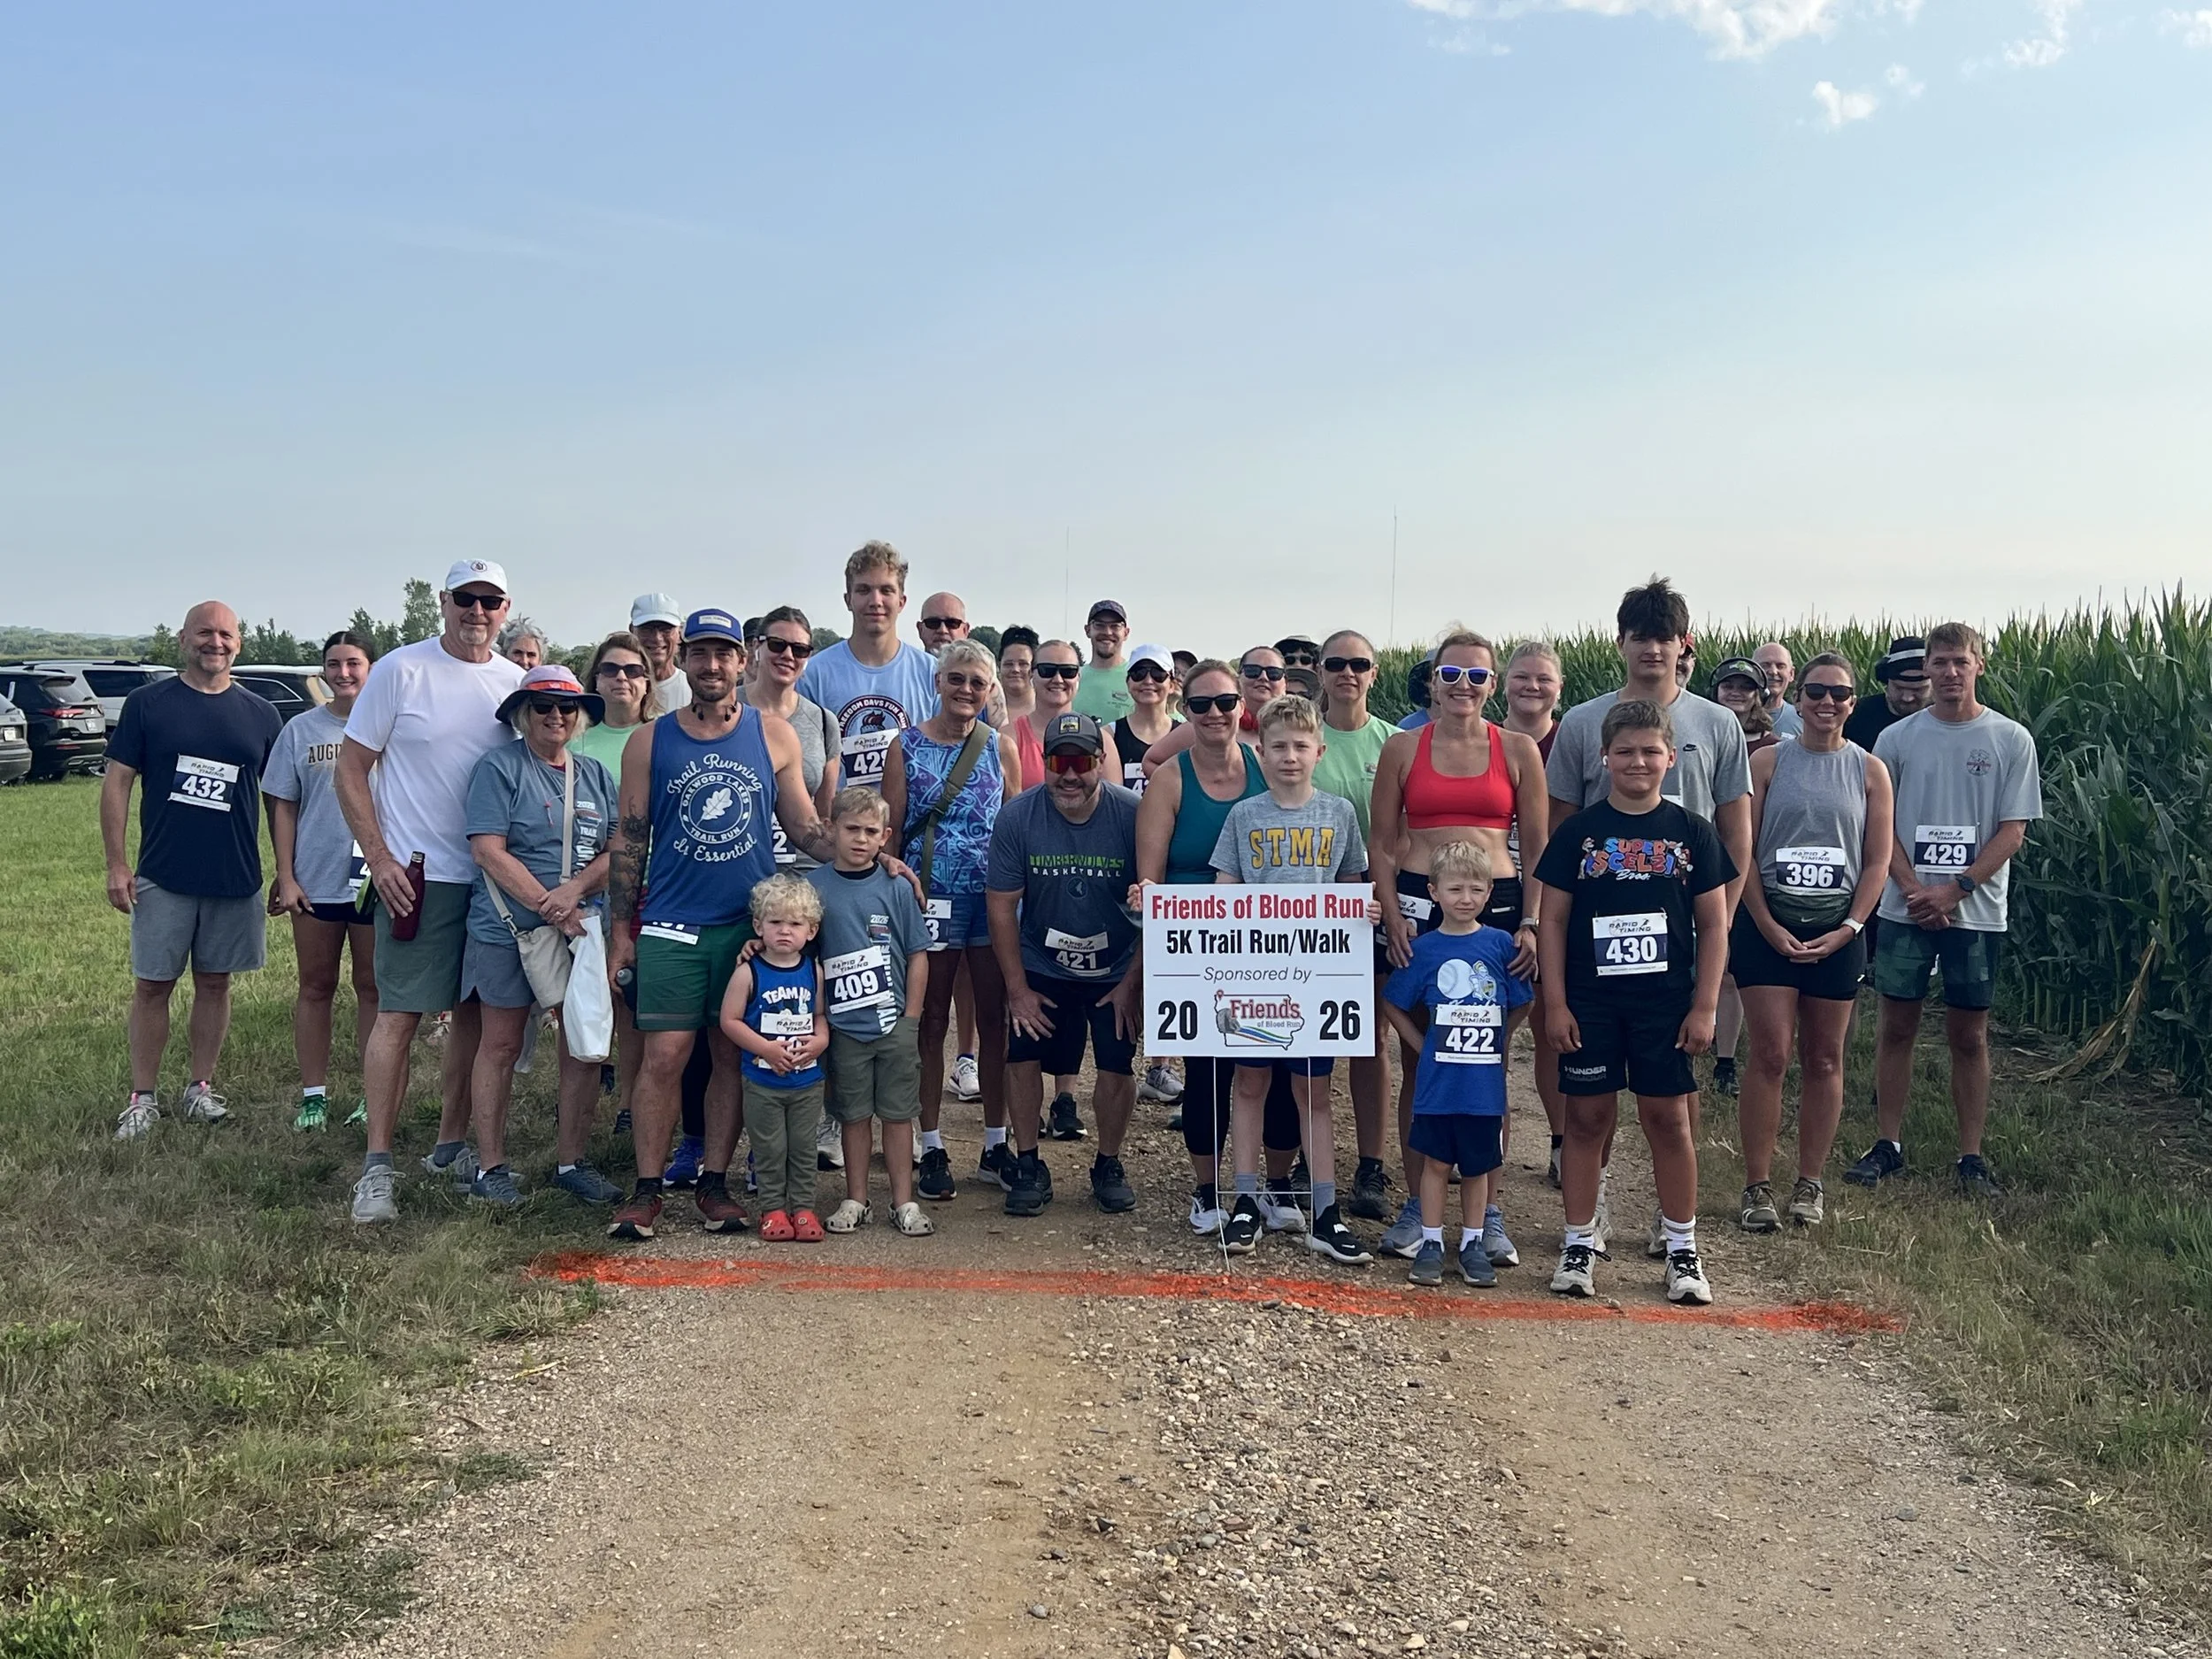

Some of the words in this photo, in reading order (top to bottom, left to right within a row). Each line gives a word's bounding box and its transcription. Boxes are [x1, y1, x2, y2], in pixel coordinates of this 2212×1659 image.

[884, 702, 901, 715] FUN
[667, 761, 702, 794] Trail
[703, 753, 763, 793] Running
[181, 775, 227, 801] 432
[682, 775, 723, 807] OAKWOOD
[726, 777, 749, 804] LAKES
[690, 827, 718, 842] TRAIL
[721, 826, 741, 841] RUN
[694, 833, 757, 862] Essential
[1248, 826, 1335, 870] STMA
[1604, 837, 1667, 856] SUPER
[1924, 844, 1967, 865] 429
[1029, 854, 1125, 868] TIMBERWOLVES
[1033, 866, 1121, 878] BASKETBALL
[1592, 850, 1676, 875] SCELZI
[1786, 863, 1834, 887] 396
[1152, 895, 1226, 919] Friends
[1233, 895, 1253, 919] of
[1259, 894, 1317, 919] Blood
[1324, 894, 1364, 918] Run
[1166, 929, 1193, 954] 5K
[1198, 929, 1242, 954] Trail
[1249, 928, 1351, 956] Run/Walk
[1606, 936, 1658, 964] 430
[832, 959, 856, 970] RAPID
[840, 962, 869, 973] TIMING
[1056, 950, 1097, 970] 421
[833, 970, 879, 1001] 409
[1203, 966, 1288, 984] Sponsored
[1293, 966, 1312, 984] by
[762, 986, 799, 1004] TEAM
[1157, 1000, 1198, 1041] 20
[1230, 998, 1301, 1019] Friends
[1319, 1000, 1361, 1041] 26
[1445, 1027, 1494, 1053] 422
